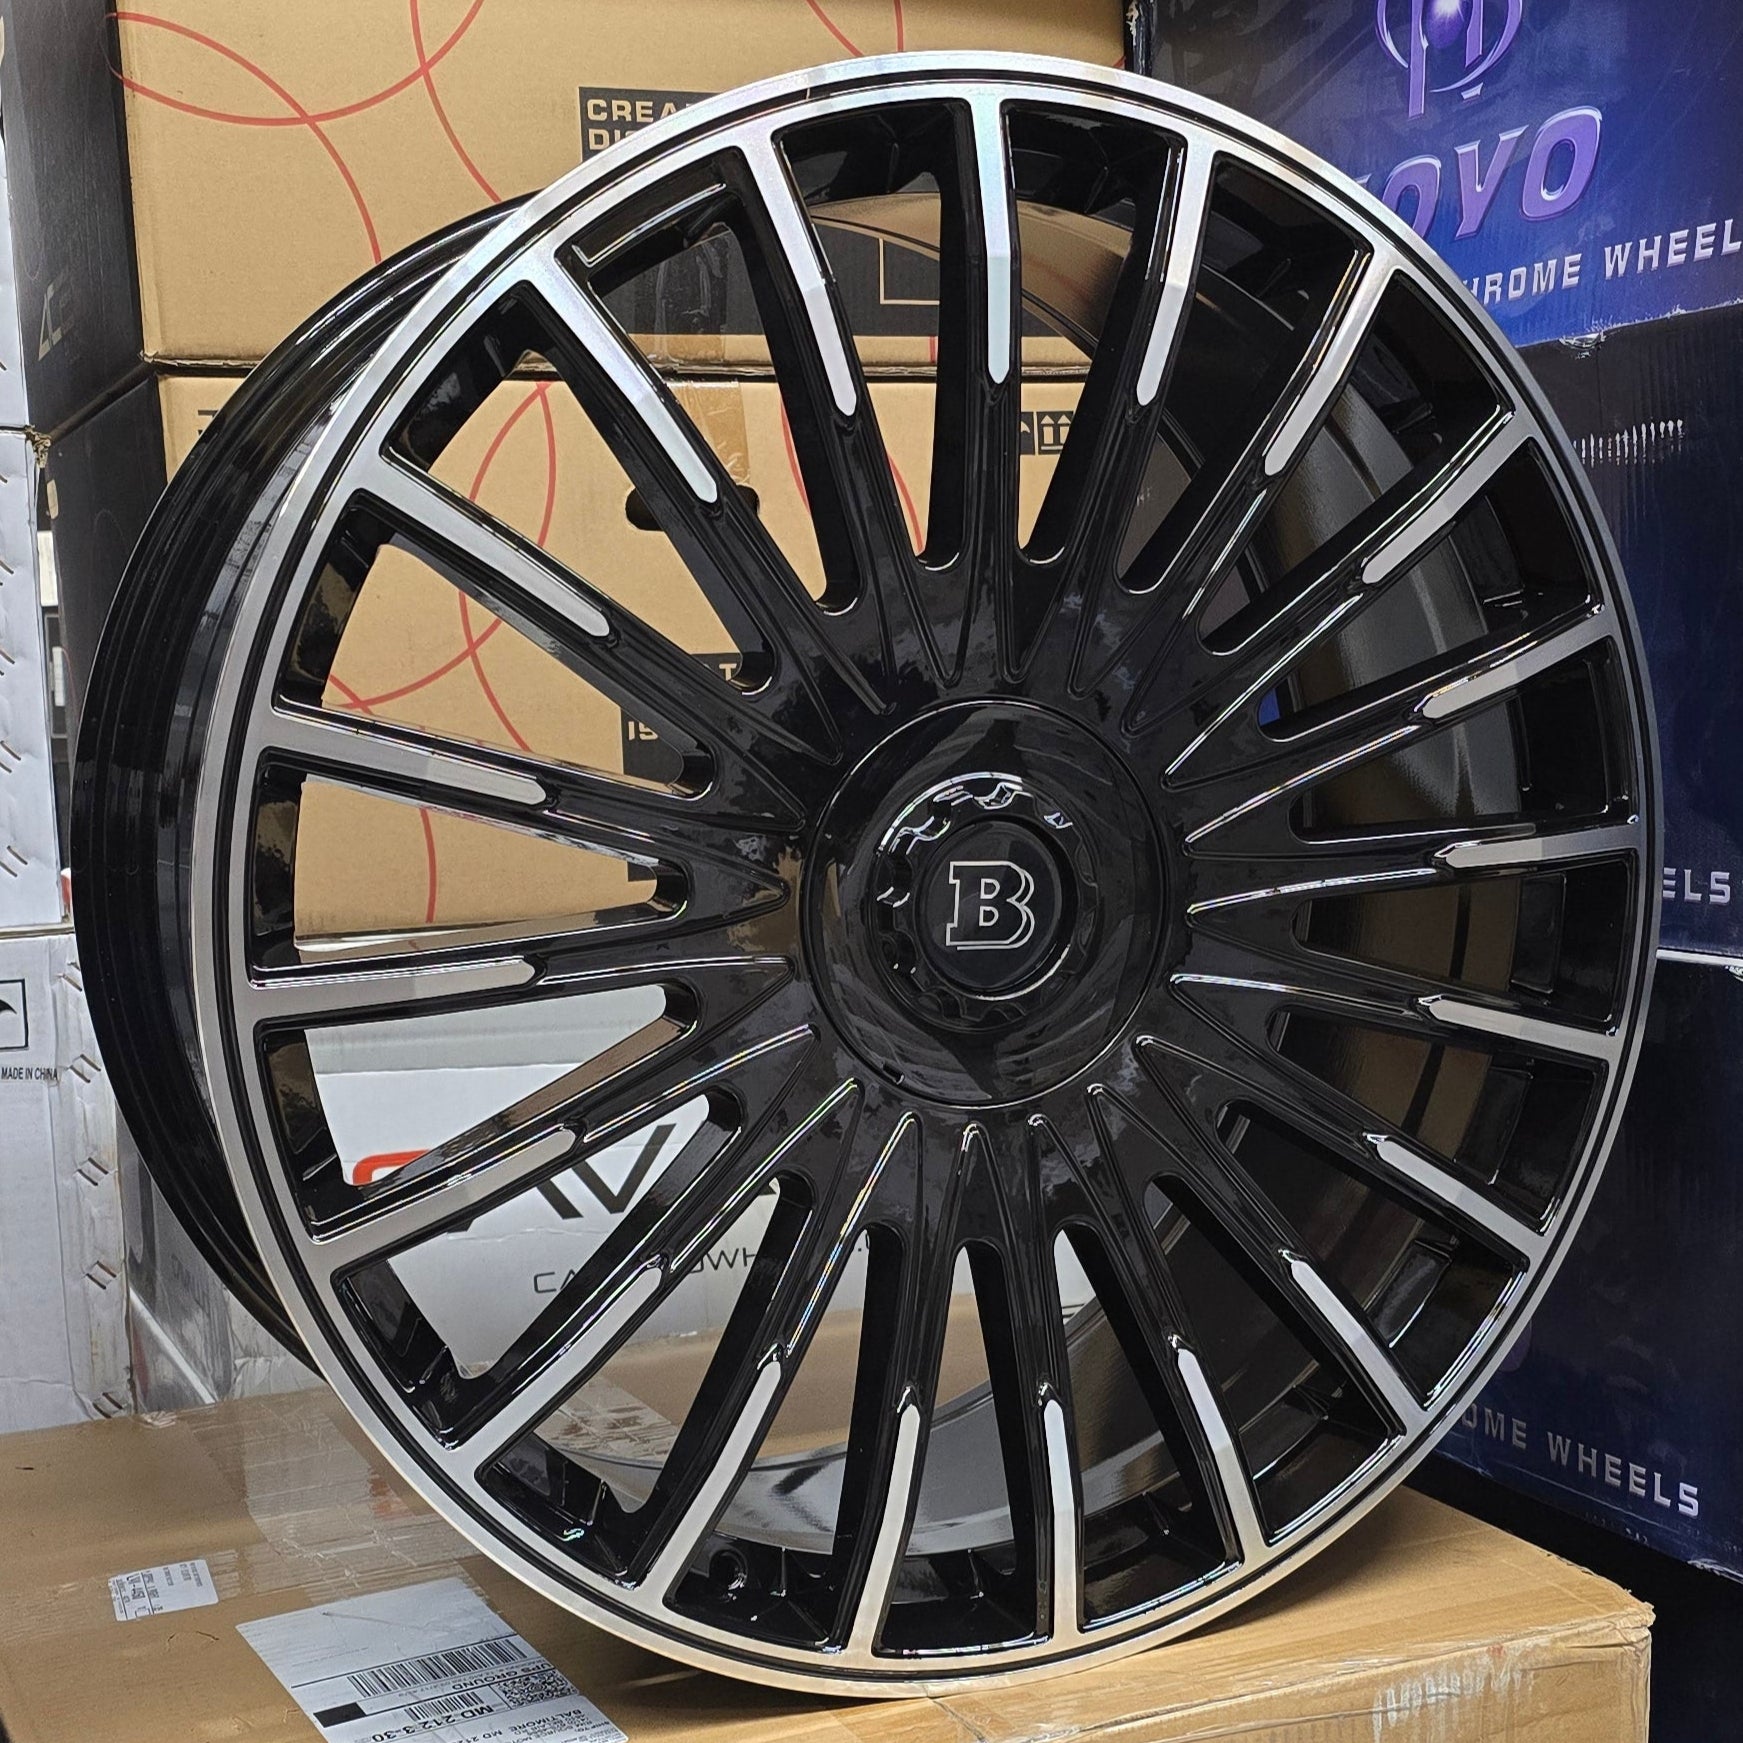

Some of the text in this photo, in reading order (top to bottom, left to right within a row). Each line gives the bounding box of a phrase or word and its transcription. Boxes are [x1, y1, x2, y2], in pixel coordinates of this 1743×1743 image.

[586, 98, 693, 124] CREA
[1357, 104, 1602, 242] OVO
[1662, 867, 1731, 905] ELS
[945, 860, 1035, 951] B
[1, 1066, 58, 1081] MADE IN CHINA
[1461, 1403, 1699, 1519] OME WHEELS
[521, 1662, 552, 1673] UPS
[452, 1670, 519, 1691] GROUND
[420, 1714, 456, 1730] 212
[460, 1704, 495, 1719] MD
[508, 1708, 582, 1733] BALTIMORE
